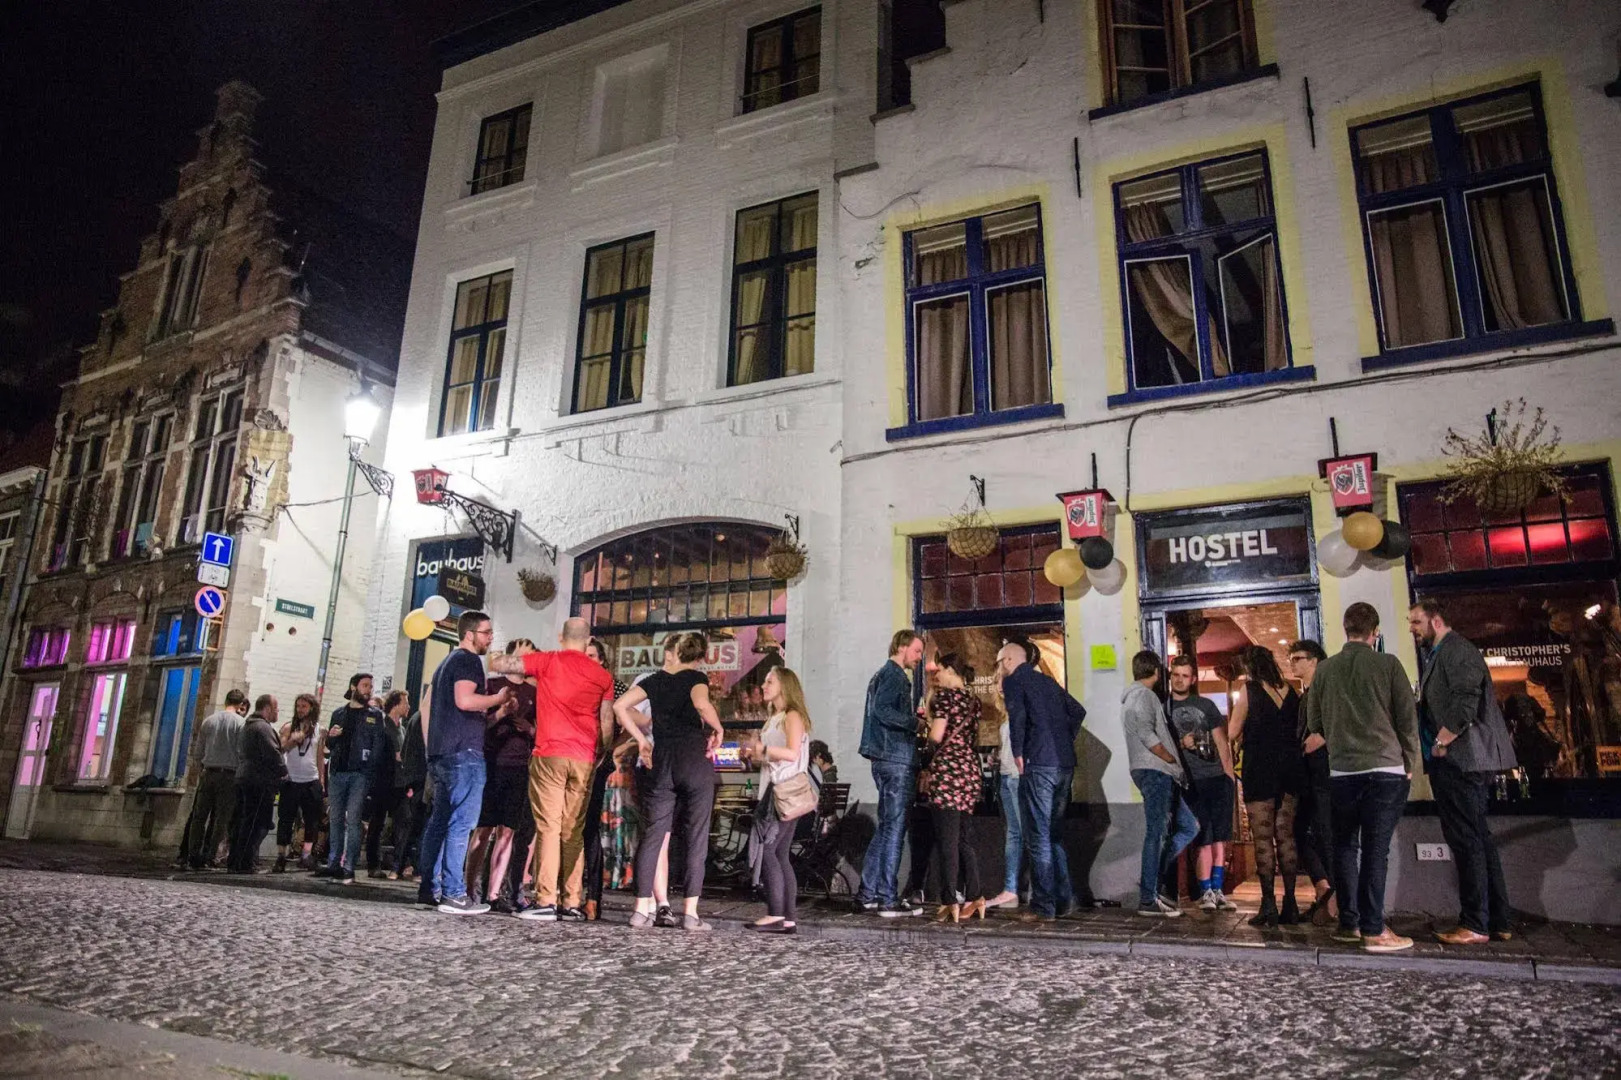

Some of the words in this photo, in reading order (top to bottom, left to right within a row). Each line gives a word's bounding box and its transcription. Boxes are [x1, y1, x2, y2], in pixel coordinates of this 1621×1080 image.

[1169, 529, 1279, 564] HOSTEL
[621, 643, 737, 669] BAUUS
[1486, 643, 1572, 657] CHRISTOPHER'S
[1437, 846, 1444, 858] 3
